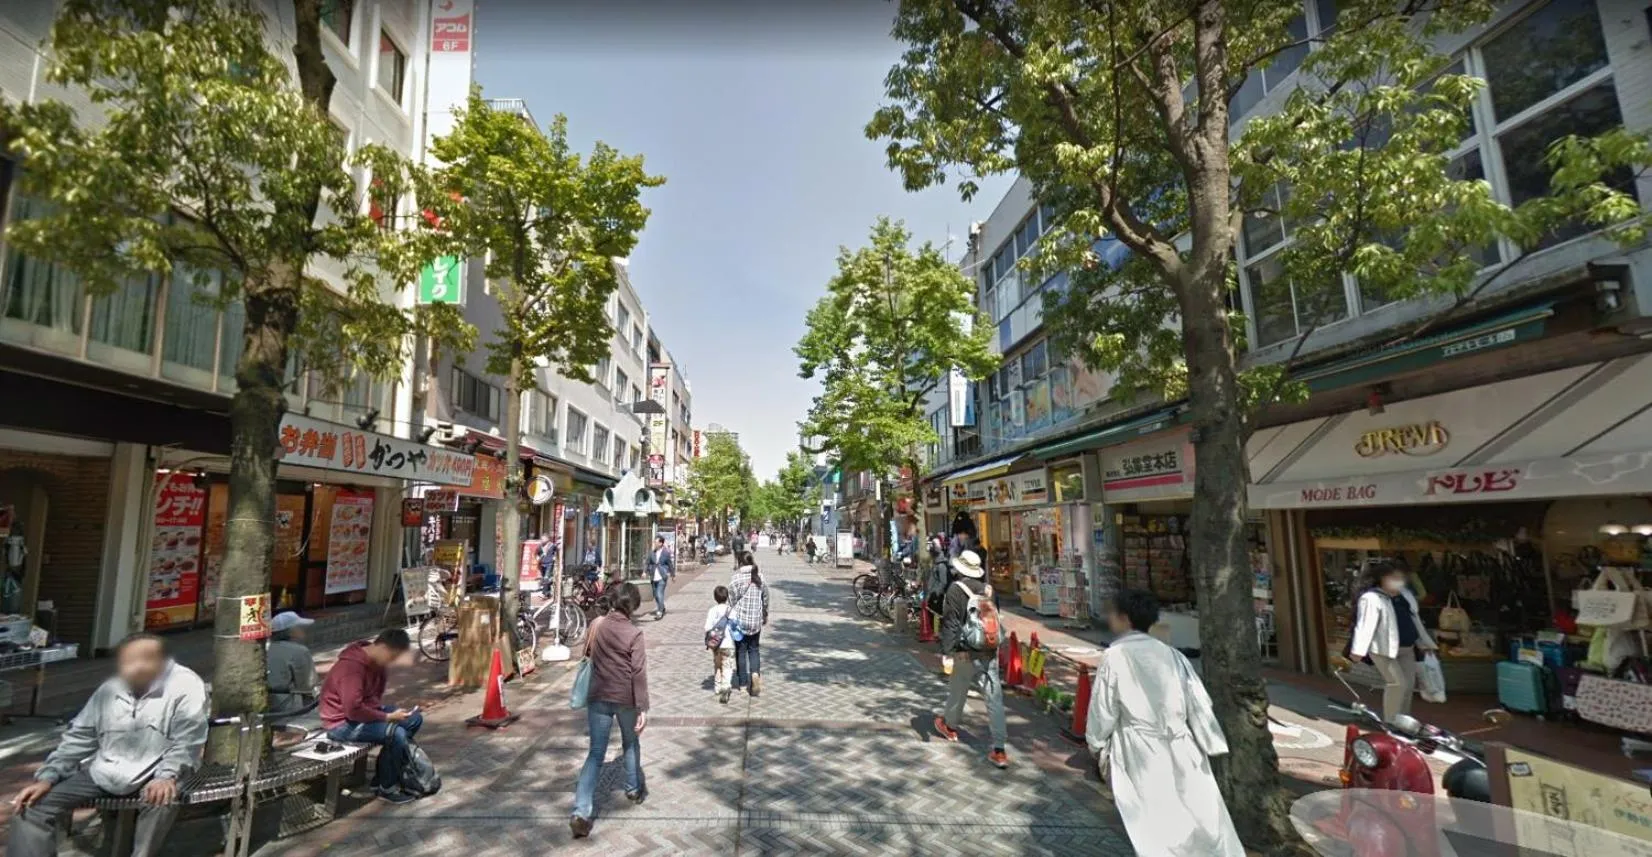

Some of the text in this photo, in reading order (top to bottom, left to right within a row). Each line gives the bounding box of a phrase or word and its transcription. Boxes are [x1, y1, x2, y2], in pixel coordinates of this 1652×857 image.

[435, 22, 467, 33] アコム
[442, 40, 459, 50] 6F
[279, 424, 338, 461] お弁当
[369, 437, 428, 472] かつや
[1301, 484, 1377, 503] MODE BAG
[1425, 469, 1520, 497] トレビ
